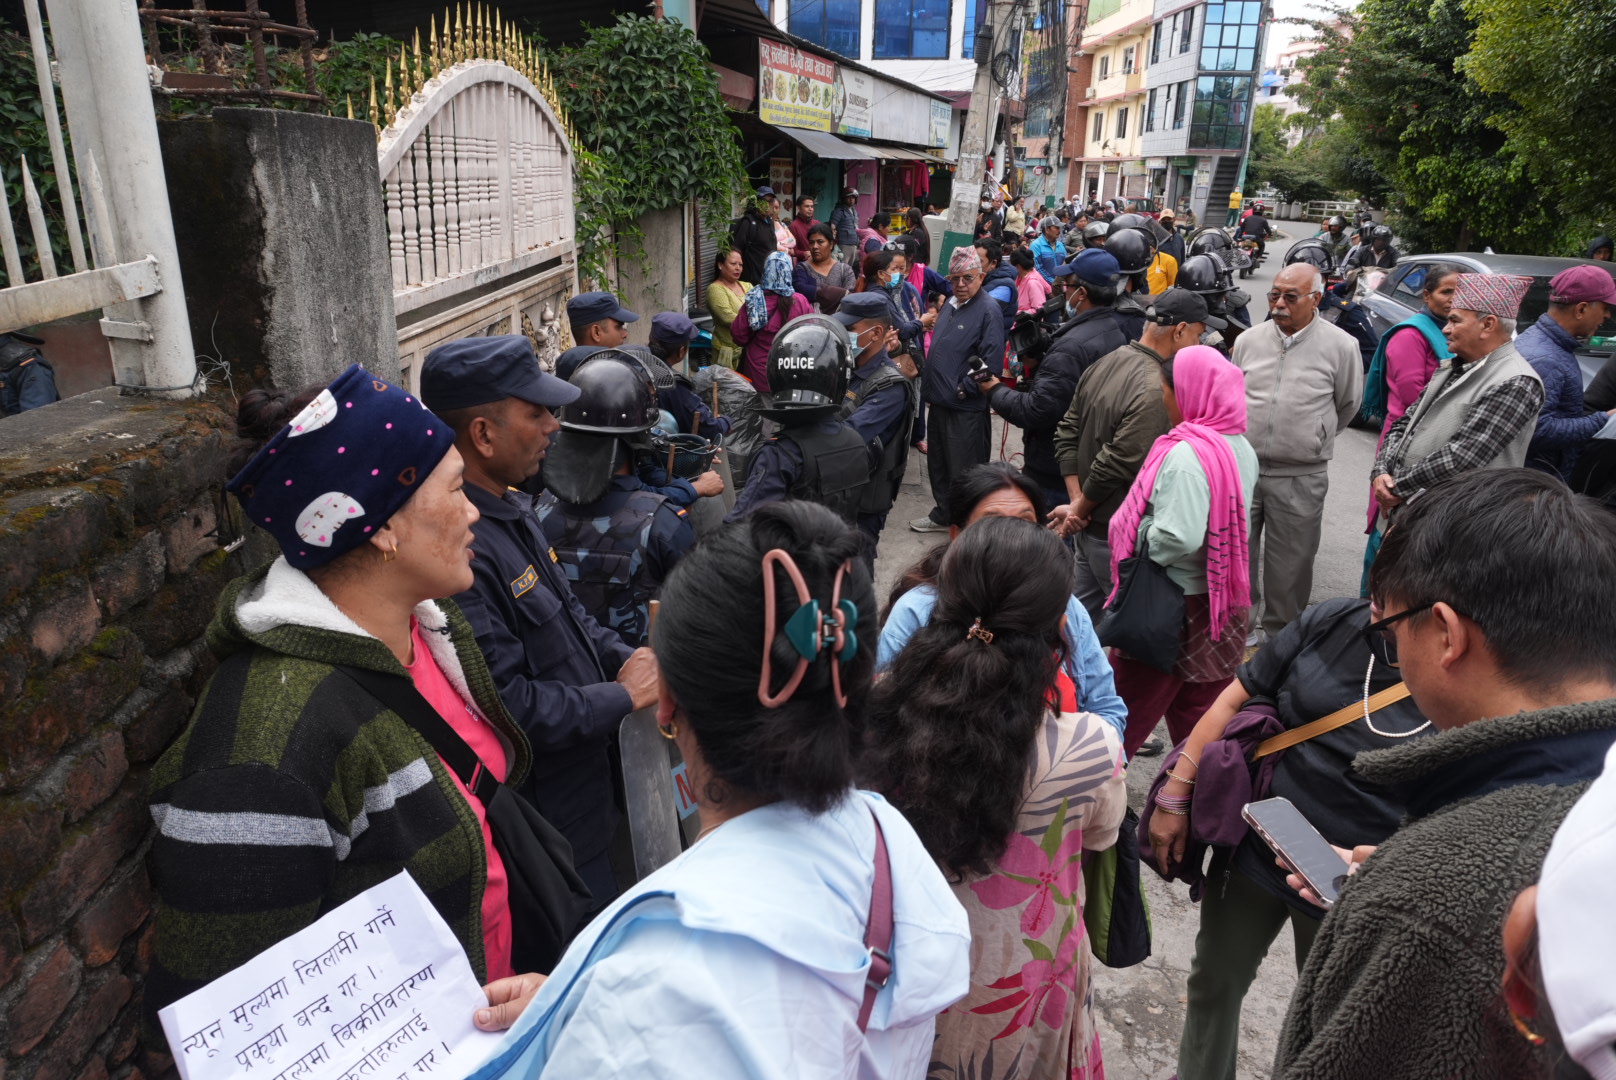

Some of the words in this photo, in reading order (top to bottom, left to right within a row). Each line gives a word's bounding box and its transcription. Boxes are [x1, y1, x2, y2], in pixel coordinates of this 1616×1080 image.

[848, 92, 869, 110] SUNSHINE
[778, 357, 815, 370] POLICE
[181, 1018, 225, 1058] न्यून
[229, 976, 290, 1032] मुल्यमा
[292, 930, 359, 985] लिलामी
[363, 904, 397, 935] गर्ने
[293, 994, 333, 1027] बन्द
[337, 973, 363, 998] गर
[272, 1041, 331, 1080] ल्यमा
